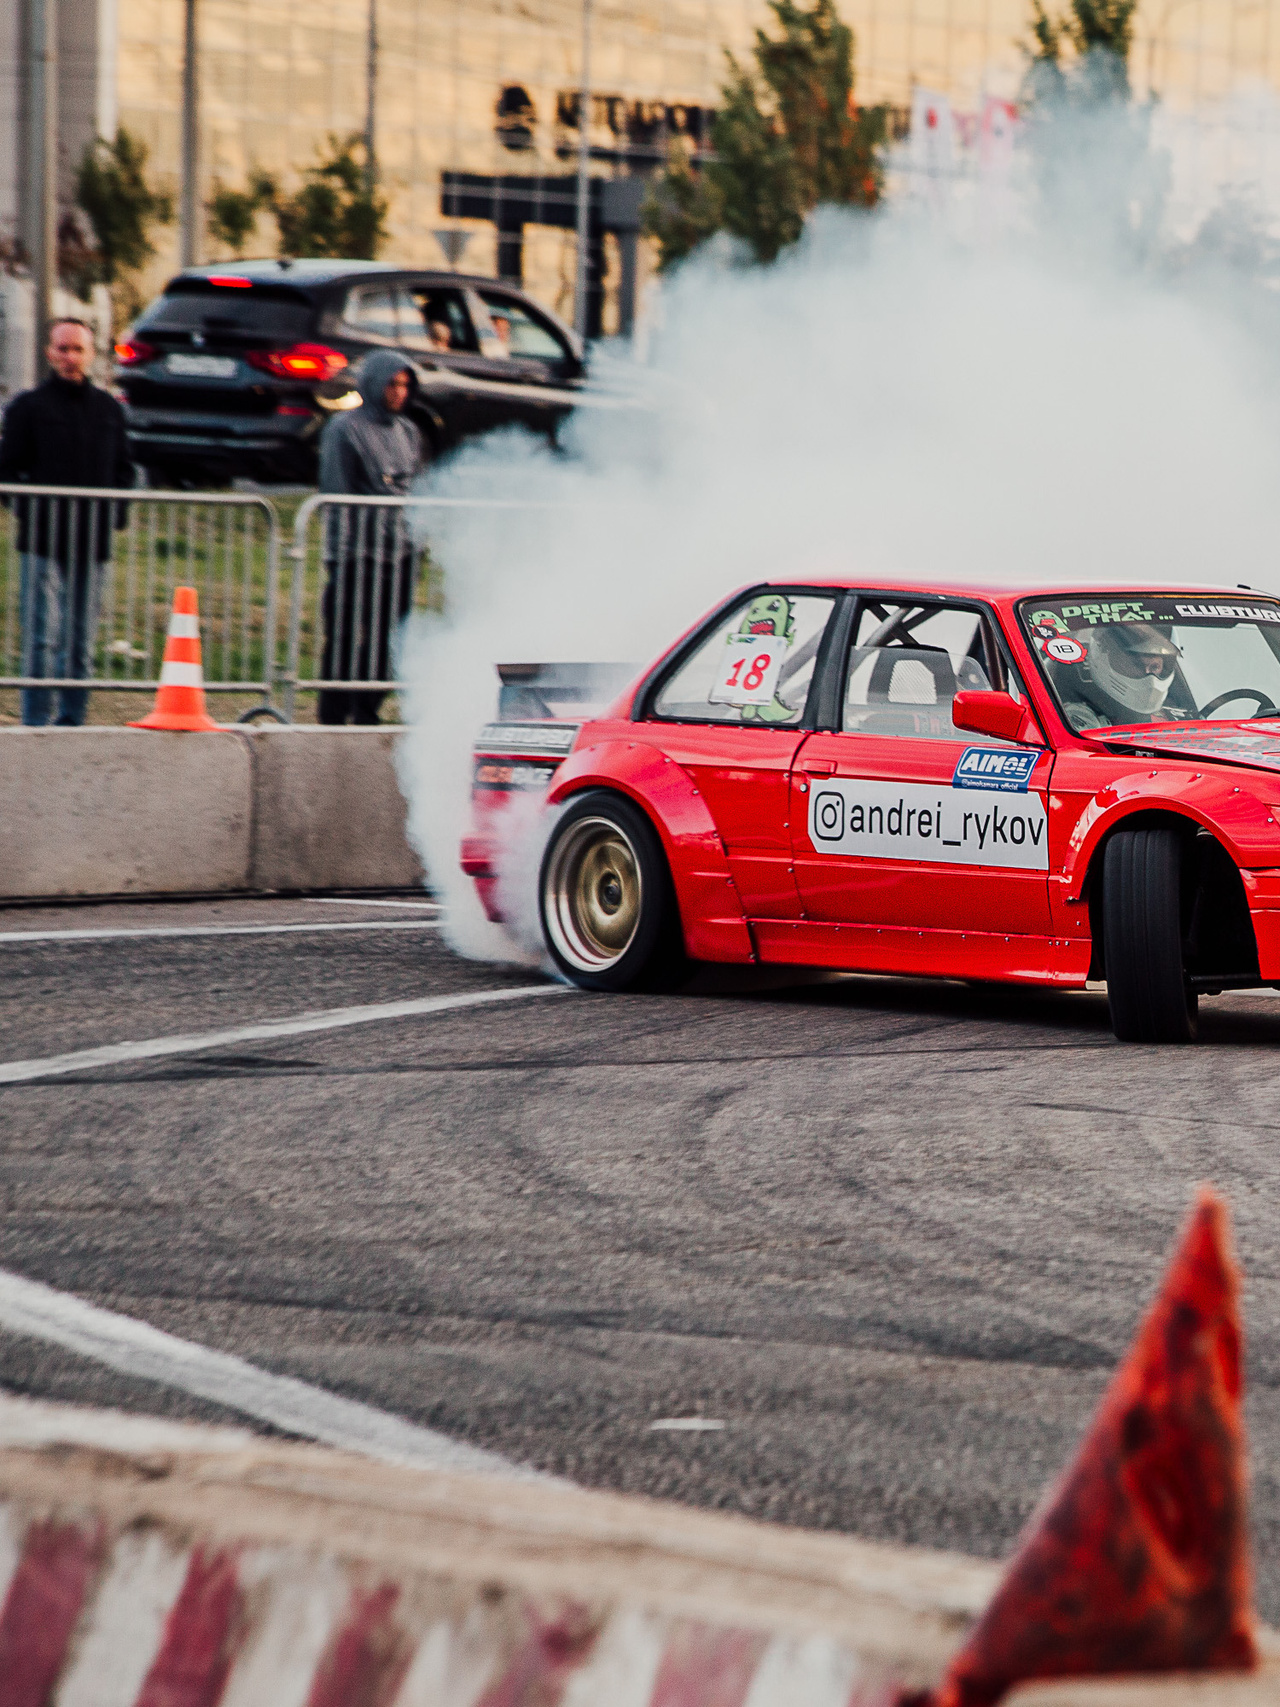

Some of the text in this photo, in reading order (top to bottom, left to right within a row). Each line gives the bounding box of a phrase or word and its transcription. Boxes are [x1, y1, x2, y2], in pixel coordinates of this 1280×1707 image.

[1062, 602, 1143, 618] DRIFT
[1053, 644, 1074, 654] 18
[725, 653, 771, 691] 18
[850, 798, 1044, 850] andrei_rykov
